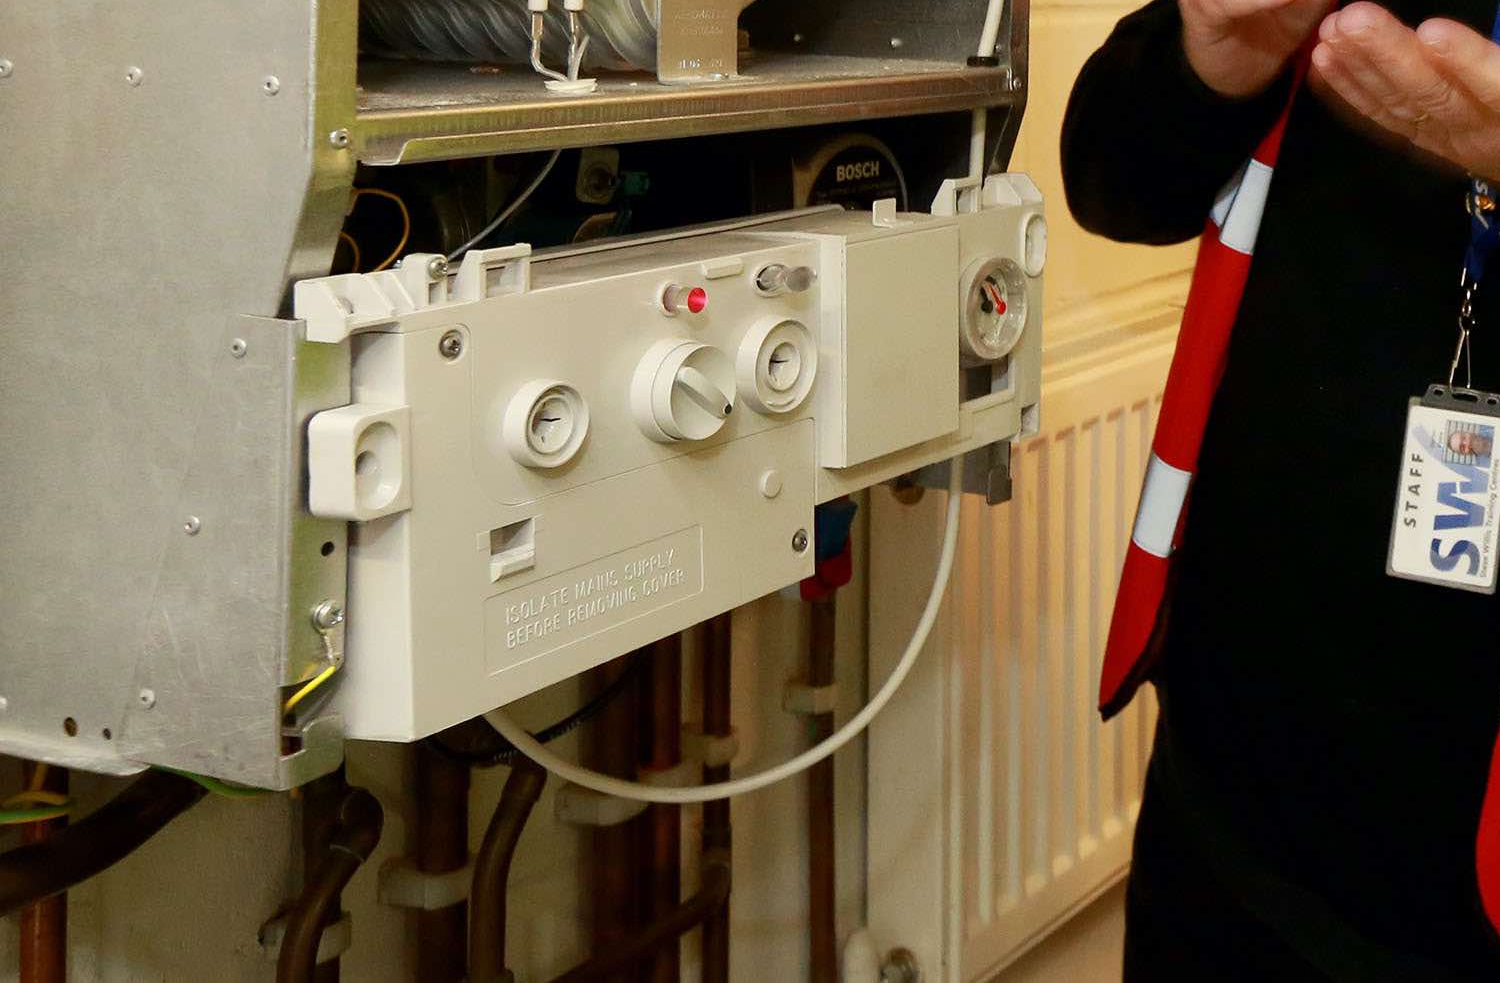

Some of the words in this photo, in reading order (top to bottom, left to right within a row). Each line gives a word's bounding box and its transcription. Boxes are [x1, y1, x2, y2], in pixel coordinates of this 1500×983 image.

[836, 160, 880, 183] BOSCH
[1404, 453, 1424, 528] STAFF
[1485, 492, 1498, 527] Training
[505, 586, 569, 626] ISOLATE
[575, 569, 618, 600] MAINS
[624, 548, 675, 581] SUPPLY
[506, 613, 561, 649] BEFORE
[567, 585, 638, 626] REMOVING
[642, 569, 685, 597] COVER
